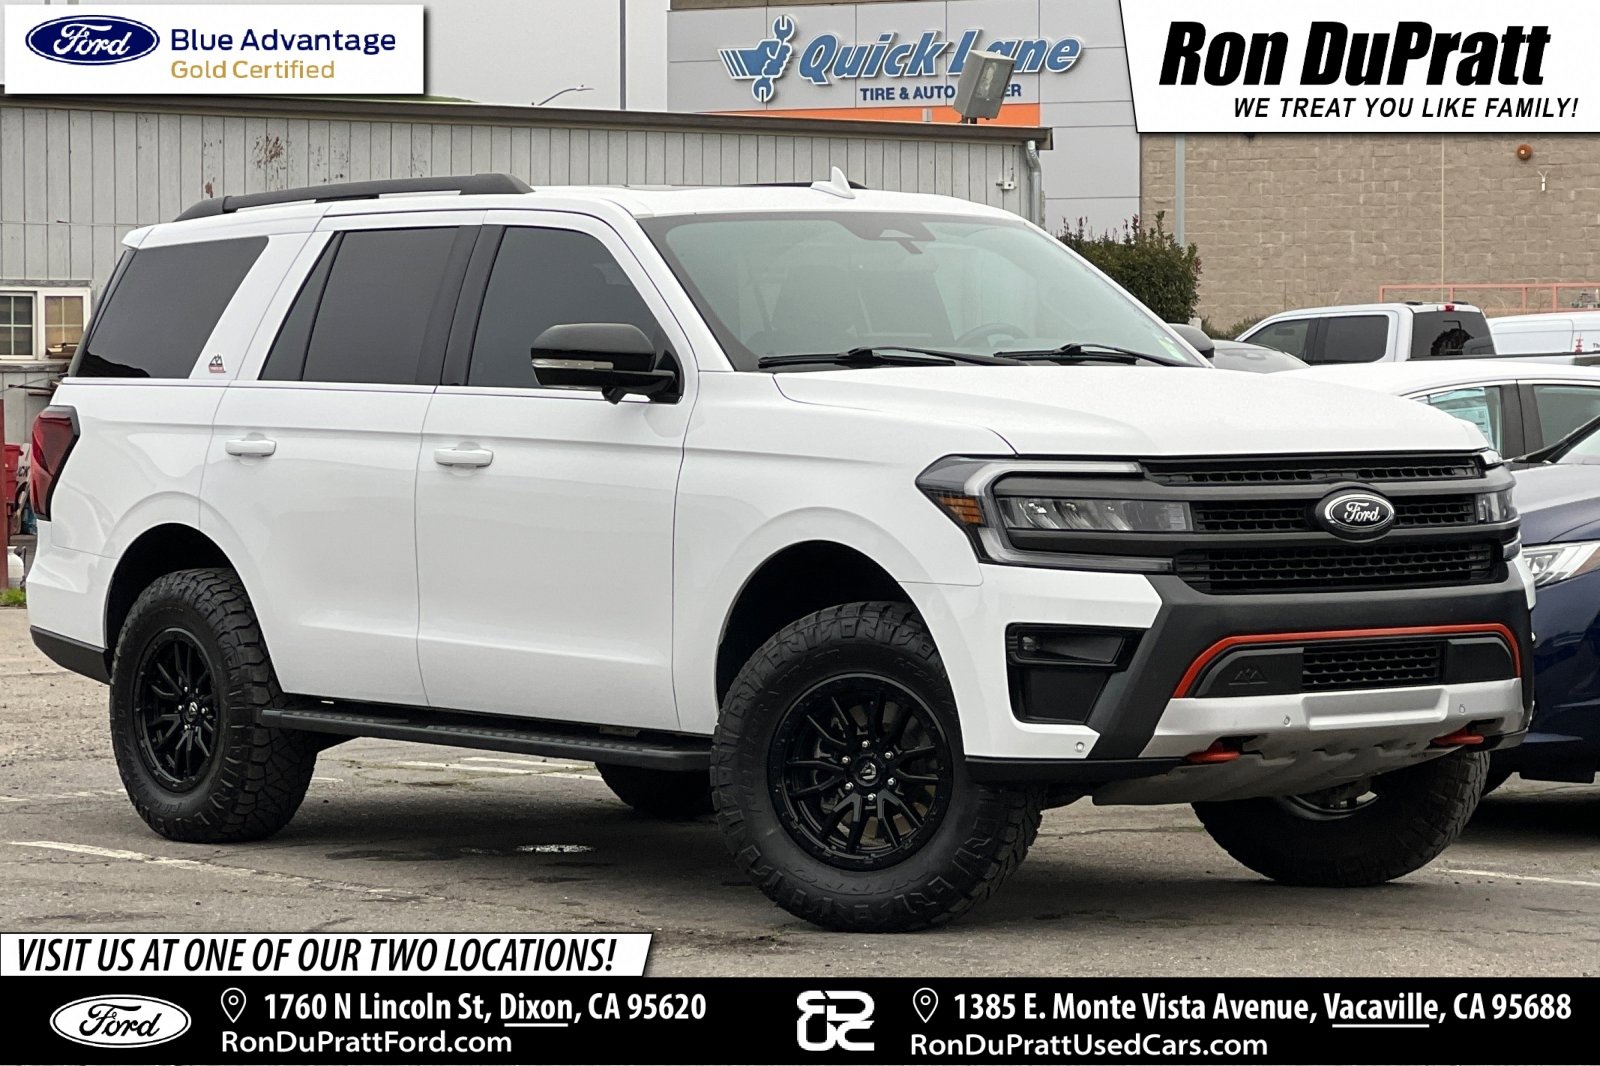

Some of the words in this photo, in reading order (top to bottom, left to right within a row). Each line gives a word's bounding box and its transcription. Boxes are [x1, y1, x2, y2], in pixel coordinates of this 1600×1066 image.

[798, 30, 950, 85] Quick
[860, 87, 895, 101] TIRE
[899, 86, 909, 100] &
[913, 85, 956, 99] AUTO
[1344, 501, 1380, 523] Ford
